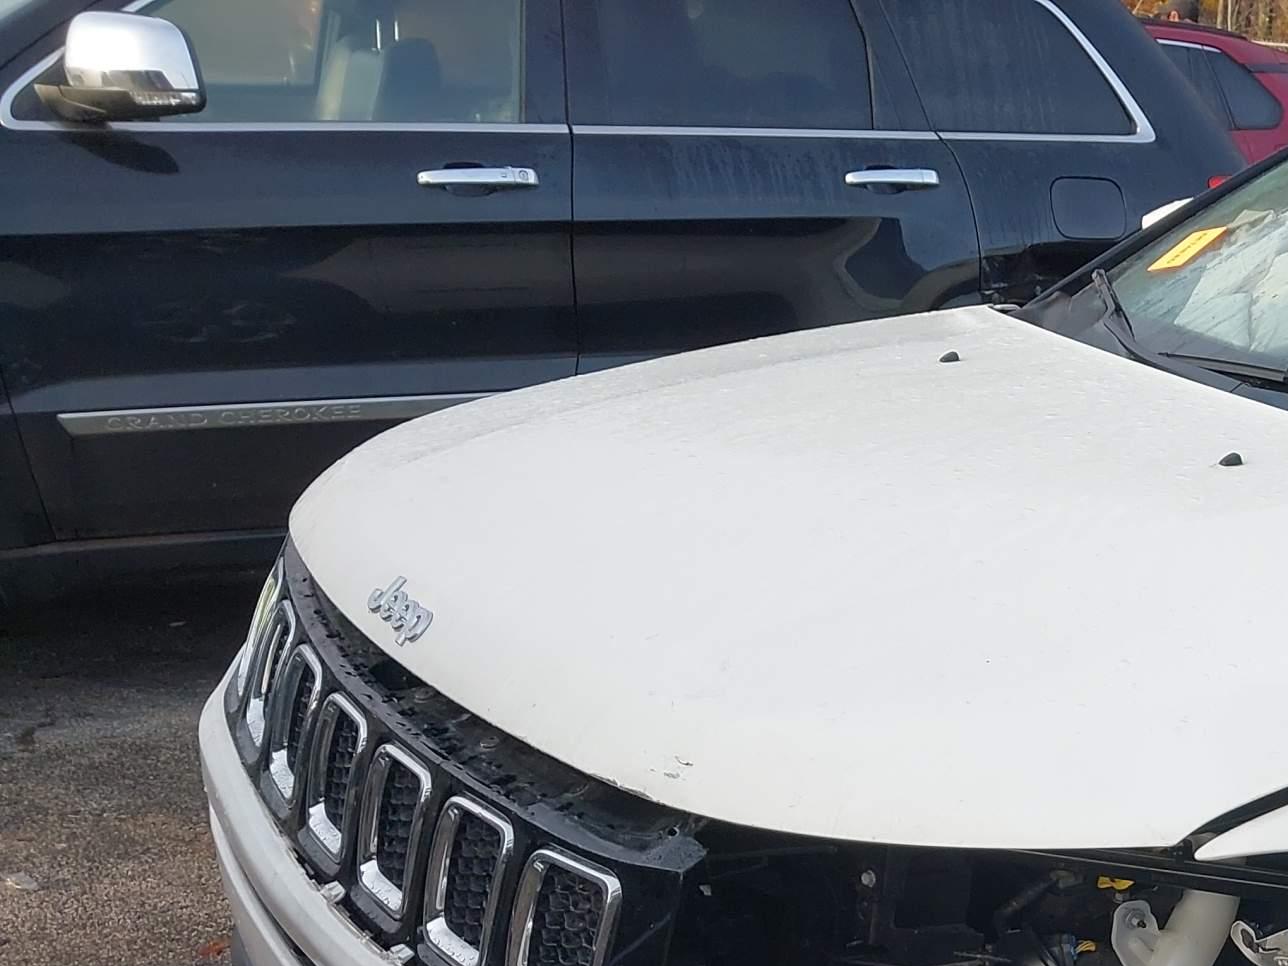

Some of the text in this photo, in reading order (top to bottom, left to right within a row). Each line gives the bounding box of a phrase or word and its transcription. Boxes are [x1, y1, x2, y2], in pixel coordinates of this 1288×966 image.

[105, 404, 362, 433] GRAND CHEROKEE
[367, 575, 434, 647] Jeep
